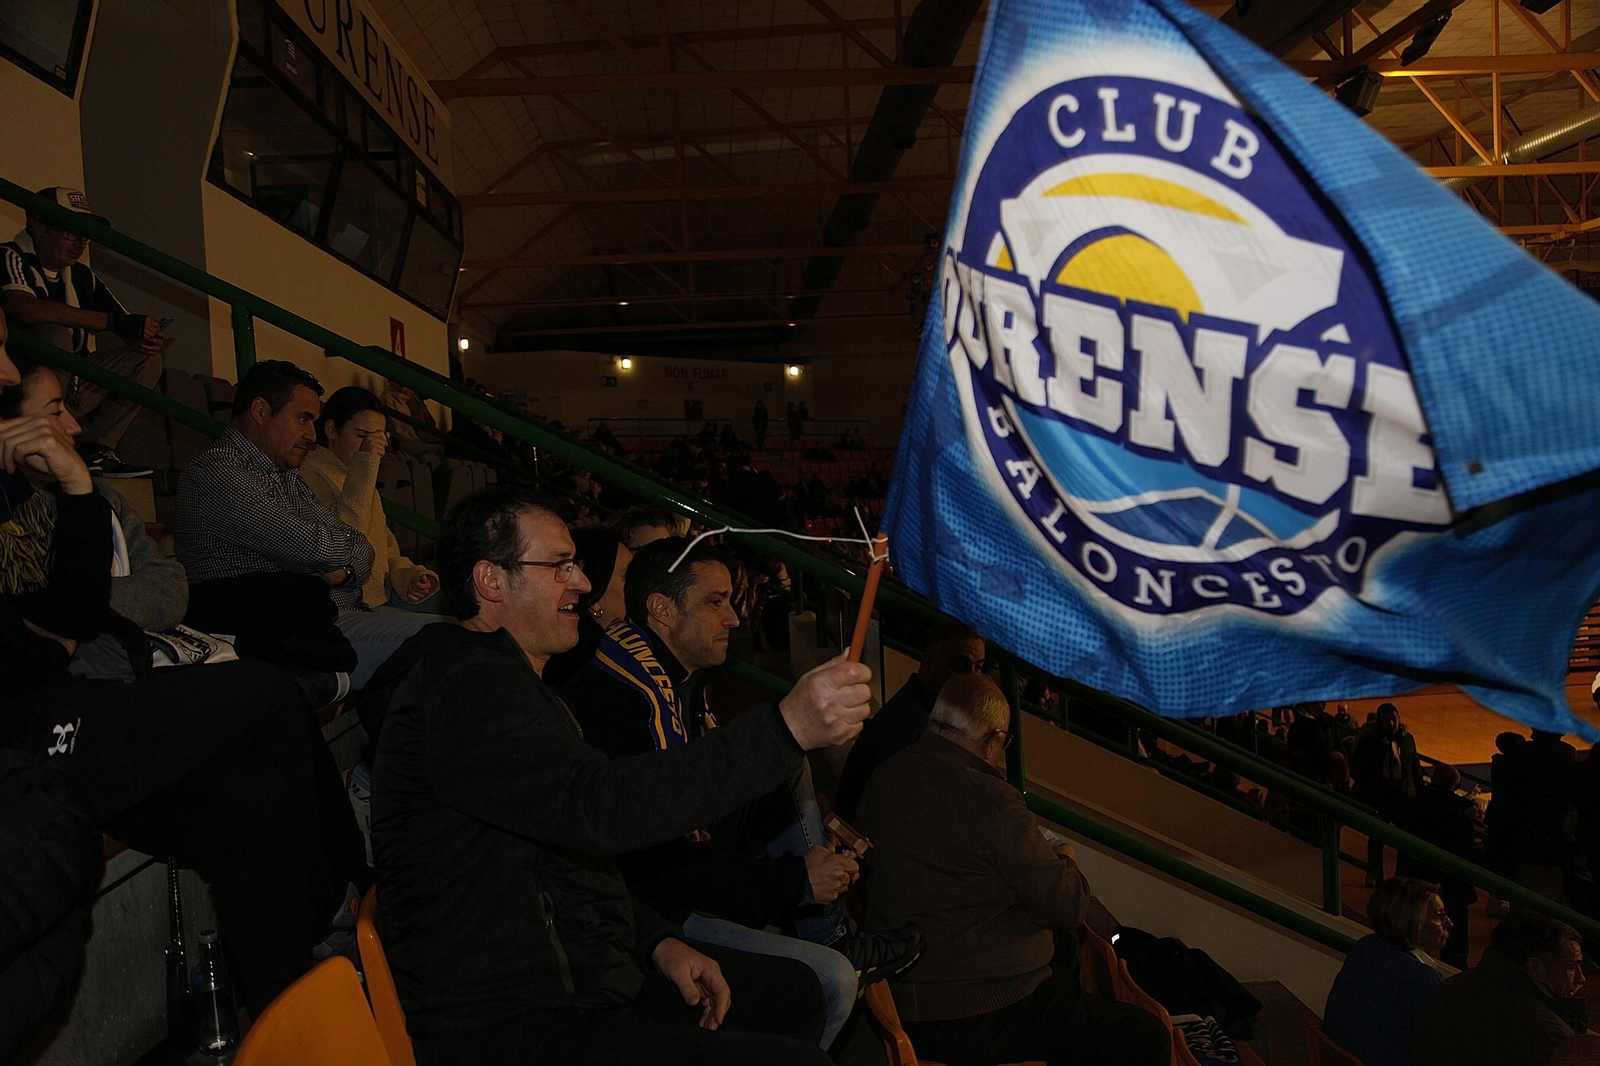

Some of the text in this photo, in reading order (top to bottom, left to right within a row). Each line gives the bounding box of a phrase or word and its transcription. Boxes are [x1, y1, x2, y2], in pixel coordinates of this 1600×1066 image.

[1047, 87, 1260, 181] CLUB
[664, 366, 729, 380] NON FUMAR
[941, 254, 1454, 526] OURENSE
[986, 405, 1368, 609] BALONCESTO
